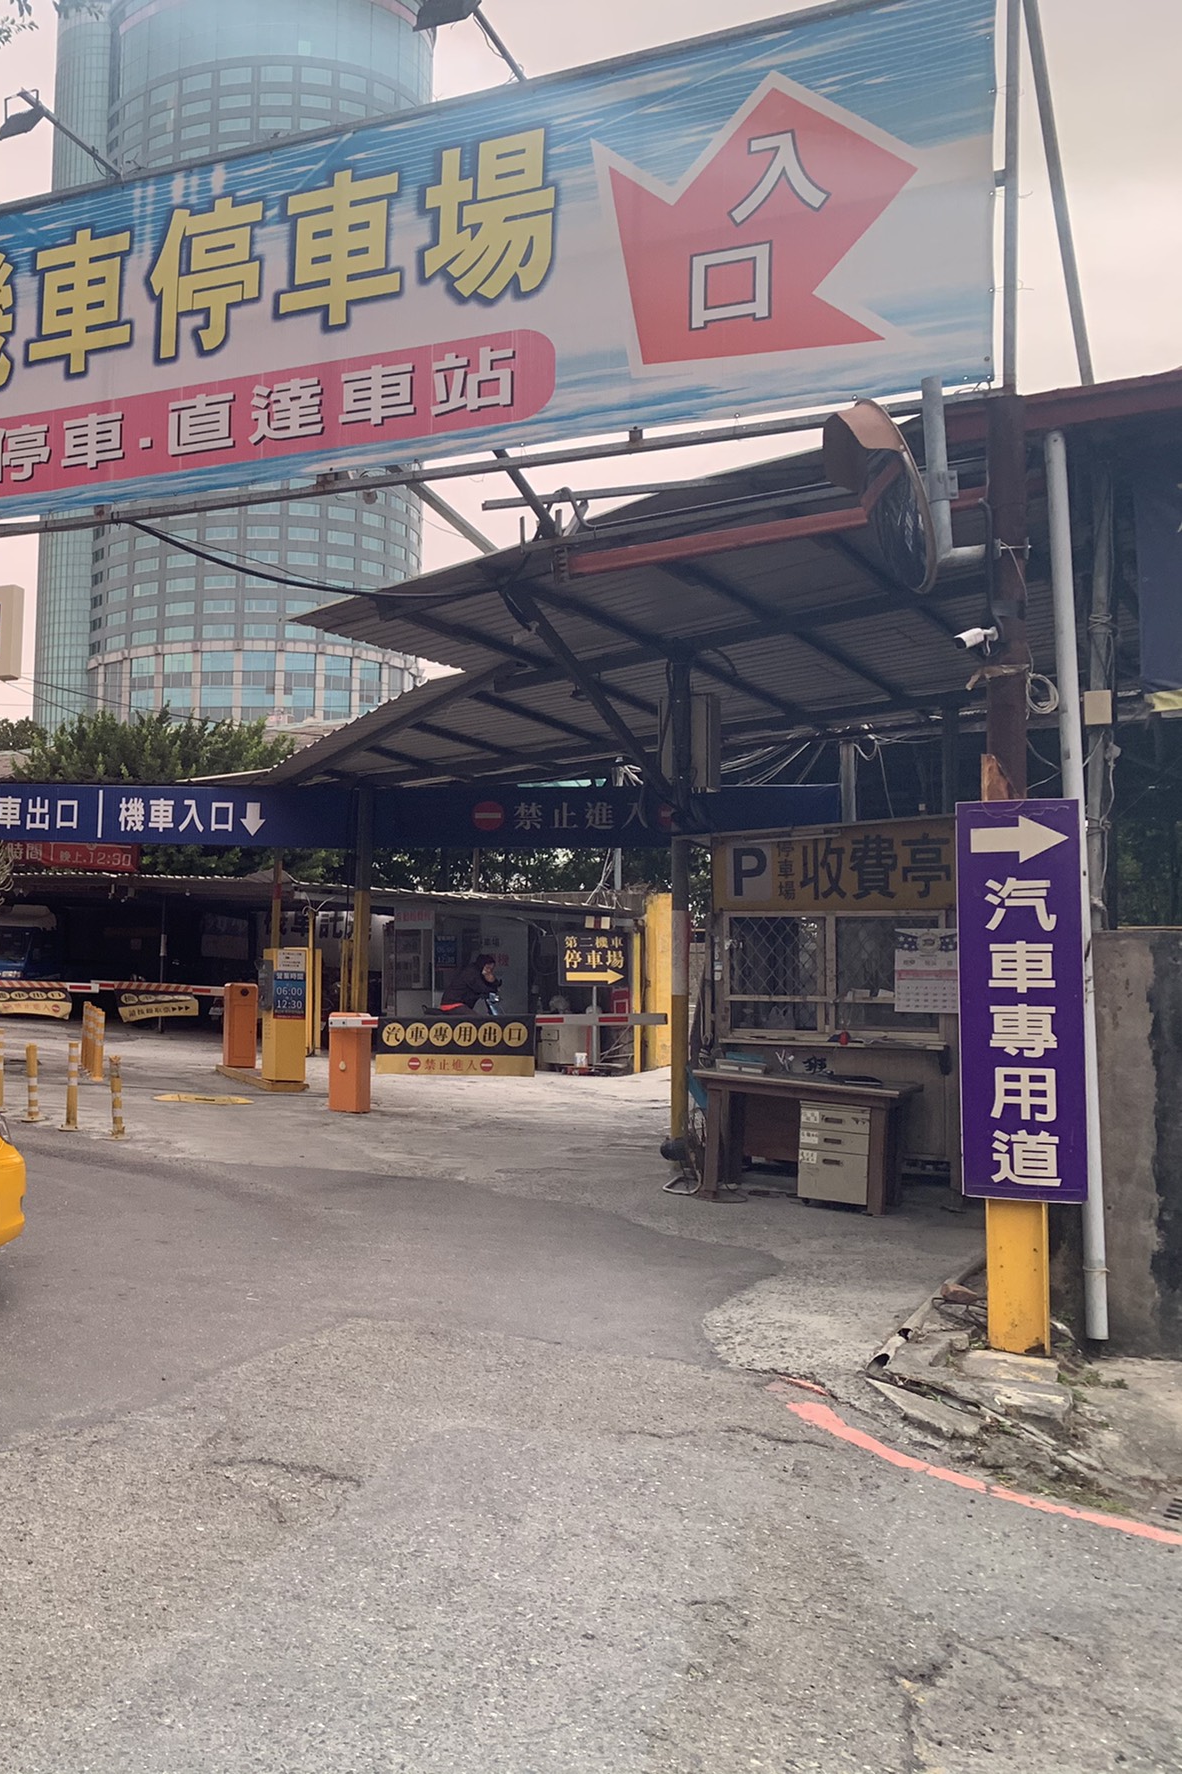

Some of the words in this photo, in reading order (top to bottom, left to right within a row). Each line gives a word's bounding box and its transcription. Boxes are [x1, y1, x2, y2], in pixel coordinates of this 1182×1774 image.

[688, 129, 832, 332] 入口
[119, 797, 234, 833] 機車入口
[513, 801, 650, 831] 禁止進入
[732, 847, 768, 897] P
[776, 841, 797, 901] 停車場
[799, 832, 953, 901] 收費亭
[564, 935, 624, 949] 第二機車
[564, 949, 625, 969] 停車場
[276, 986, 303, 996] 06:00
[277, 999, 303, 1009] 12:30
[385, 1025, 522, 1043] 汽車專用出口
[983, 876, 1063, 1189] 汽車專用道
[424, 1058, 478, 1072] 禁止進入
